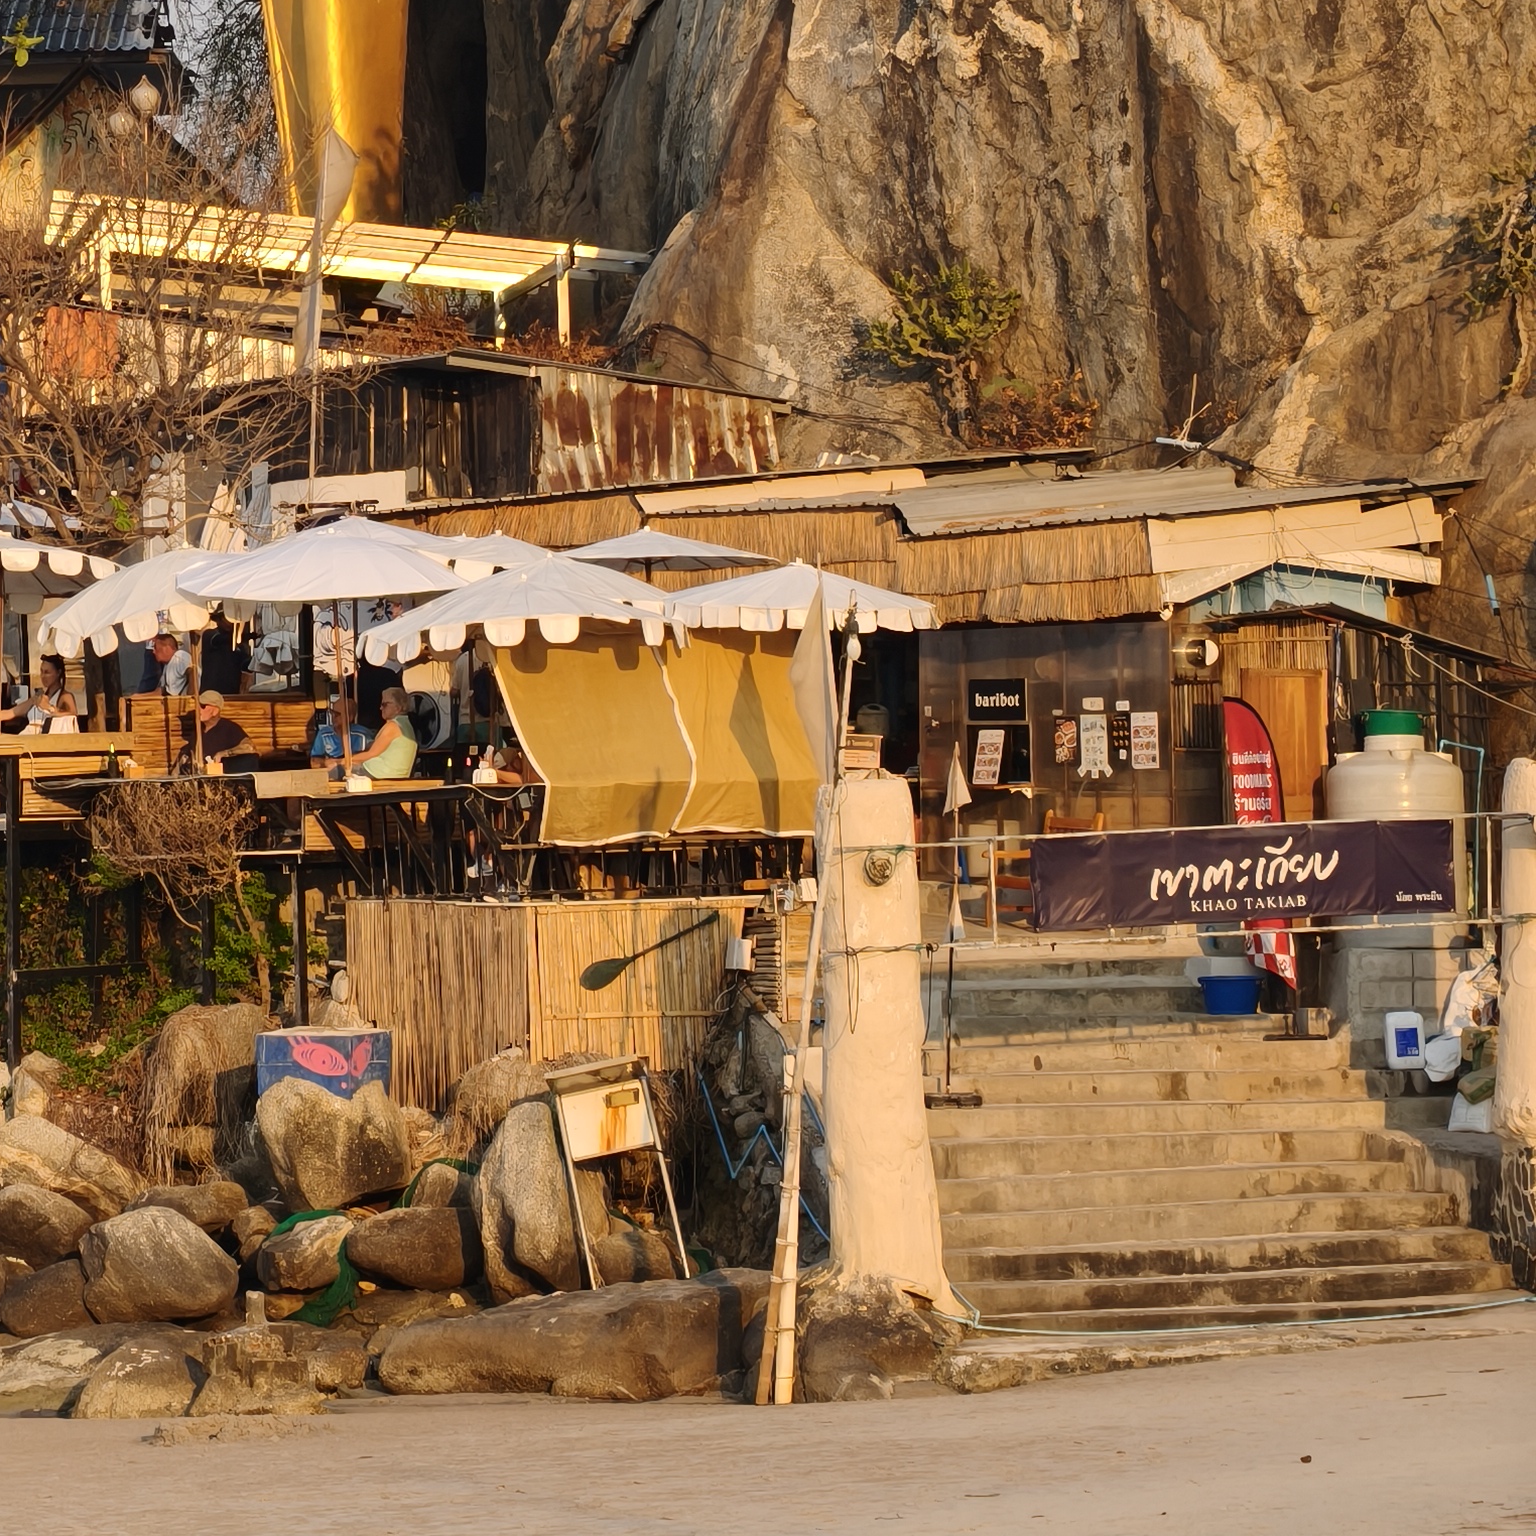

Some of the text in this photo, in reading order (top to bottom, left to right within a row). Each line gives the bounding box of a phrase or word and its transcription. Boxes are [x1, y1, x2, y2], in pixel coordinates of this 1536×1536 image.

[975, 692, 1020, 708] baribot
[1190, 895, 1307, 912] KHAO TAKIAB
